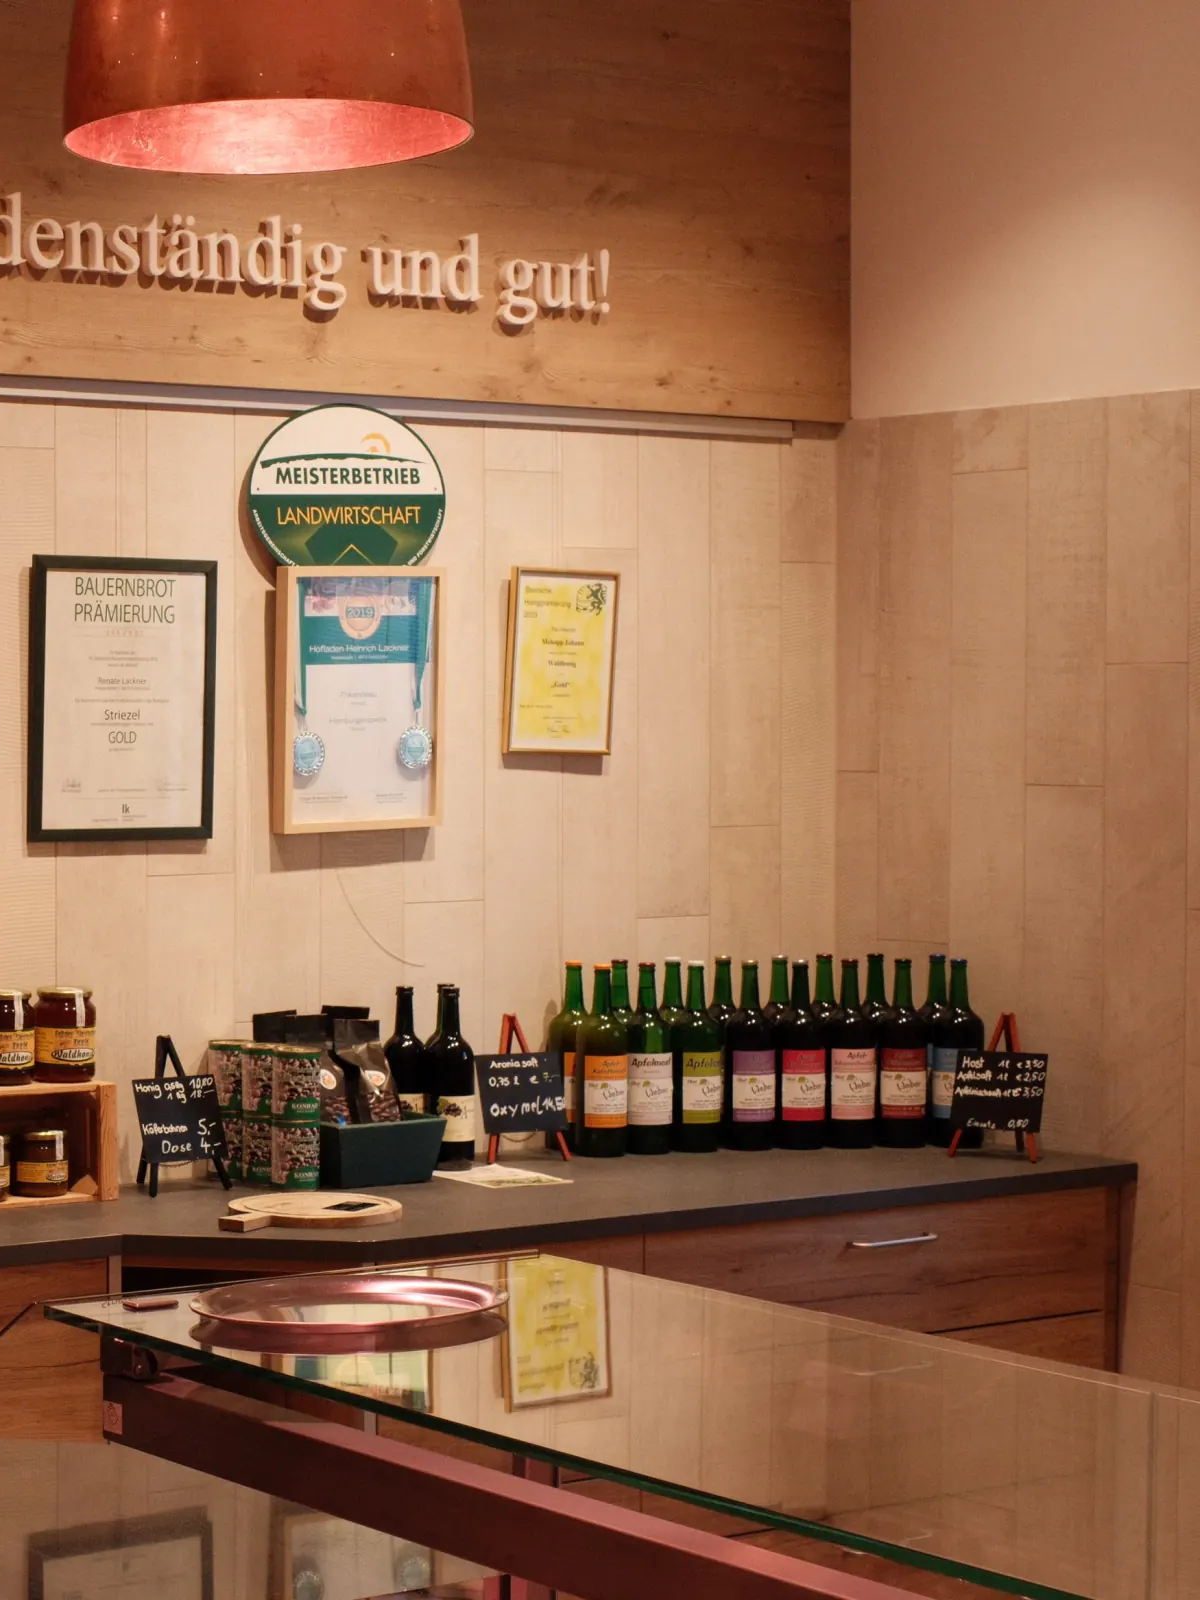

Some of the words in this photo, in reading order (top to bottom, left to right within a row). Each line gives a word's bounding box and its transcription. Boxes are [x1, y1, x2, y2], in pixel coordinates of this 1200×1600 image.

[366, 233, 483, 301] und
[497, 247, 610, 326] gut!
[275, 466, 421, 486] MEISTERBETRIEB
[276, 505, 421, 526] LANDWIRTSCHAFT
[252, 508, 296, 567] ARBEITSGEMEINSCHAFT
[74, 576, 177, 598] BAUERNBROT
[73, 600, 176, 625] PRÄMIERUNG
[346, 607, 374, 618] 2019
[309, 644, 345, 653] Hofladen
[346, 644, 377, 653] Heinrich
[97, 676, 121, 685] Renate
[121, 676, 147, 685] Lackner
[104, 708, 141, 721] Striezel
[108, 730, 138, 744] GOLD
[630, 1056, 672, 1069] Apfelmost
[1024, 1059, 1045, 1071] 3,50
[135, 1081, 162, 1099] Honig
[189, 1077, 213, 1090] 10,80
[488, 1076, 510, 1088] 0,75
[141, 1122, 189, 1136] Käferbohnen
[161, 1139, 193, 1155] Dose
